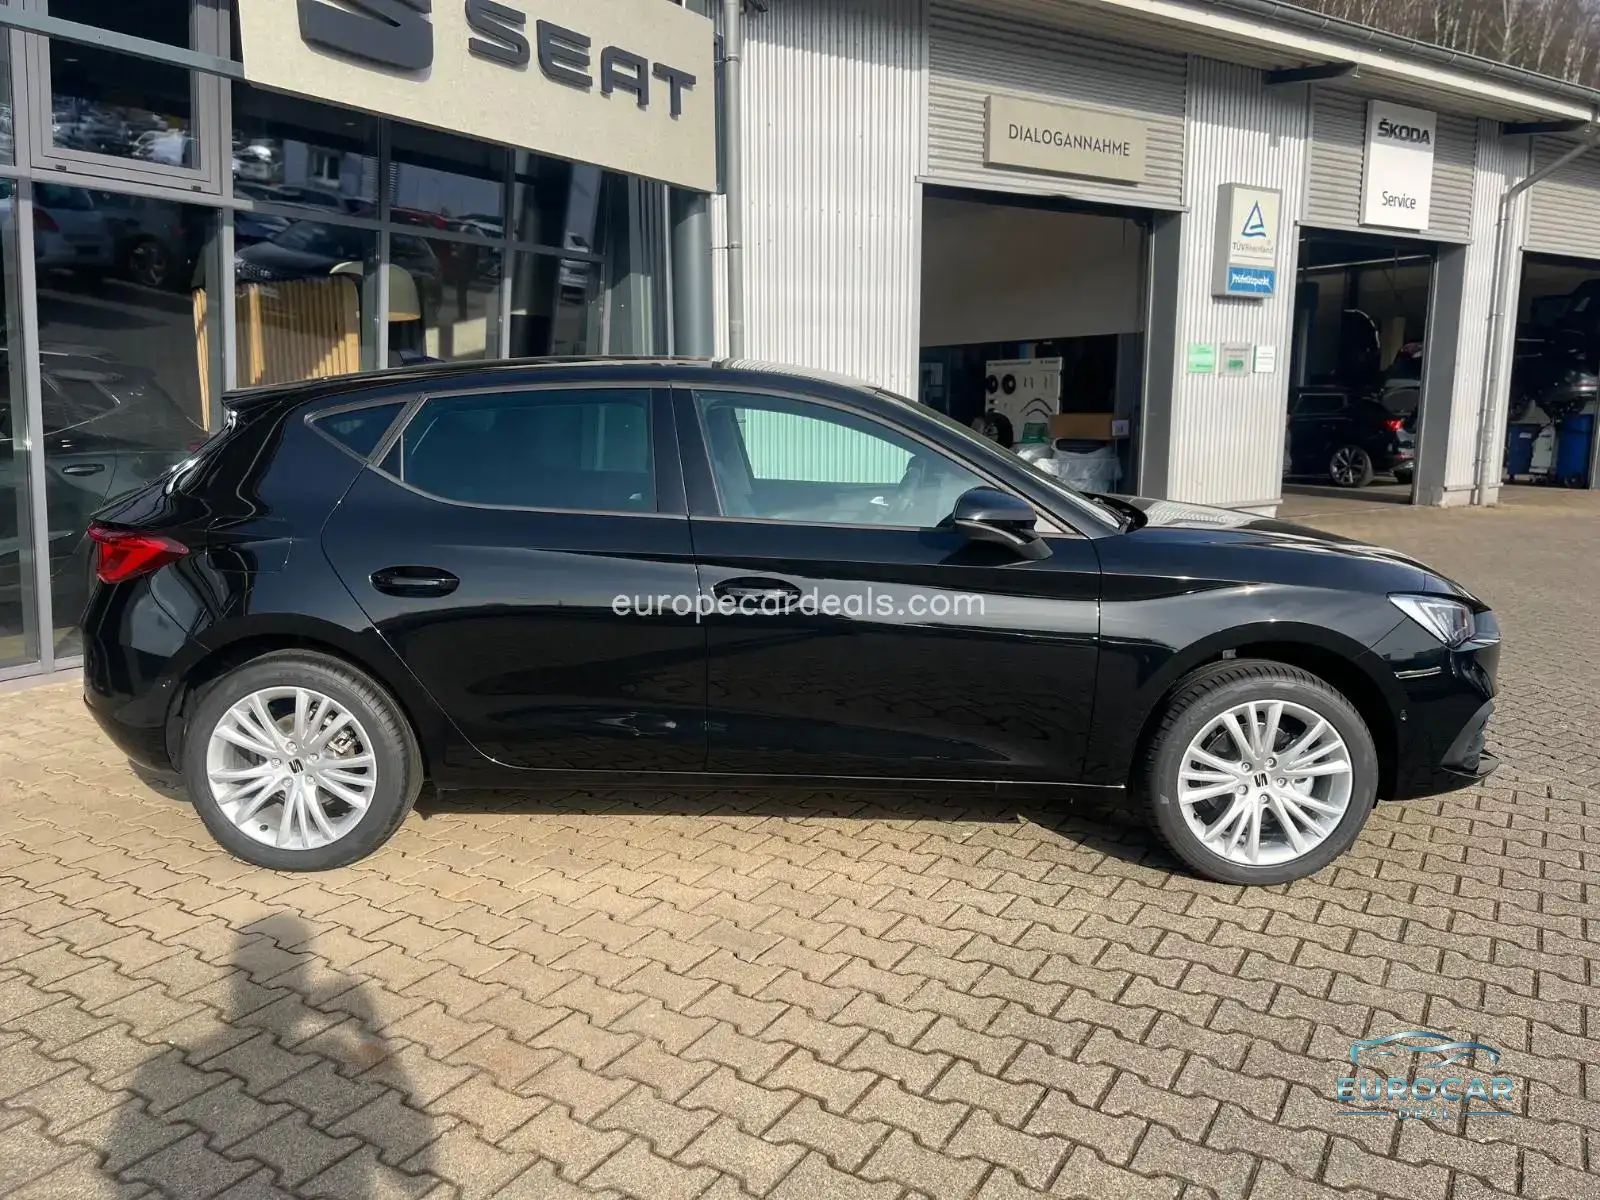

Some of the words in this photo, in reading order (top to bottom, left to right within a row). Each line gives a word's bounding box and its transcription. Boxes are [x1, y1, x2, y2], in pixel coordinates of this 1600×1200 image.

[465, 0, 697, 117] SEAT
[1008, 123, 1131, 156] DIALOGANNAHME
[1377, 117, 1431, 145] ŠKODA
[1381, 190, 1417, 209] Service
